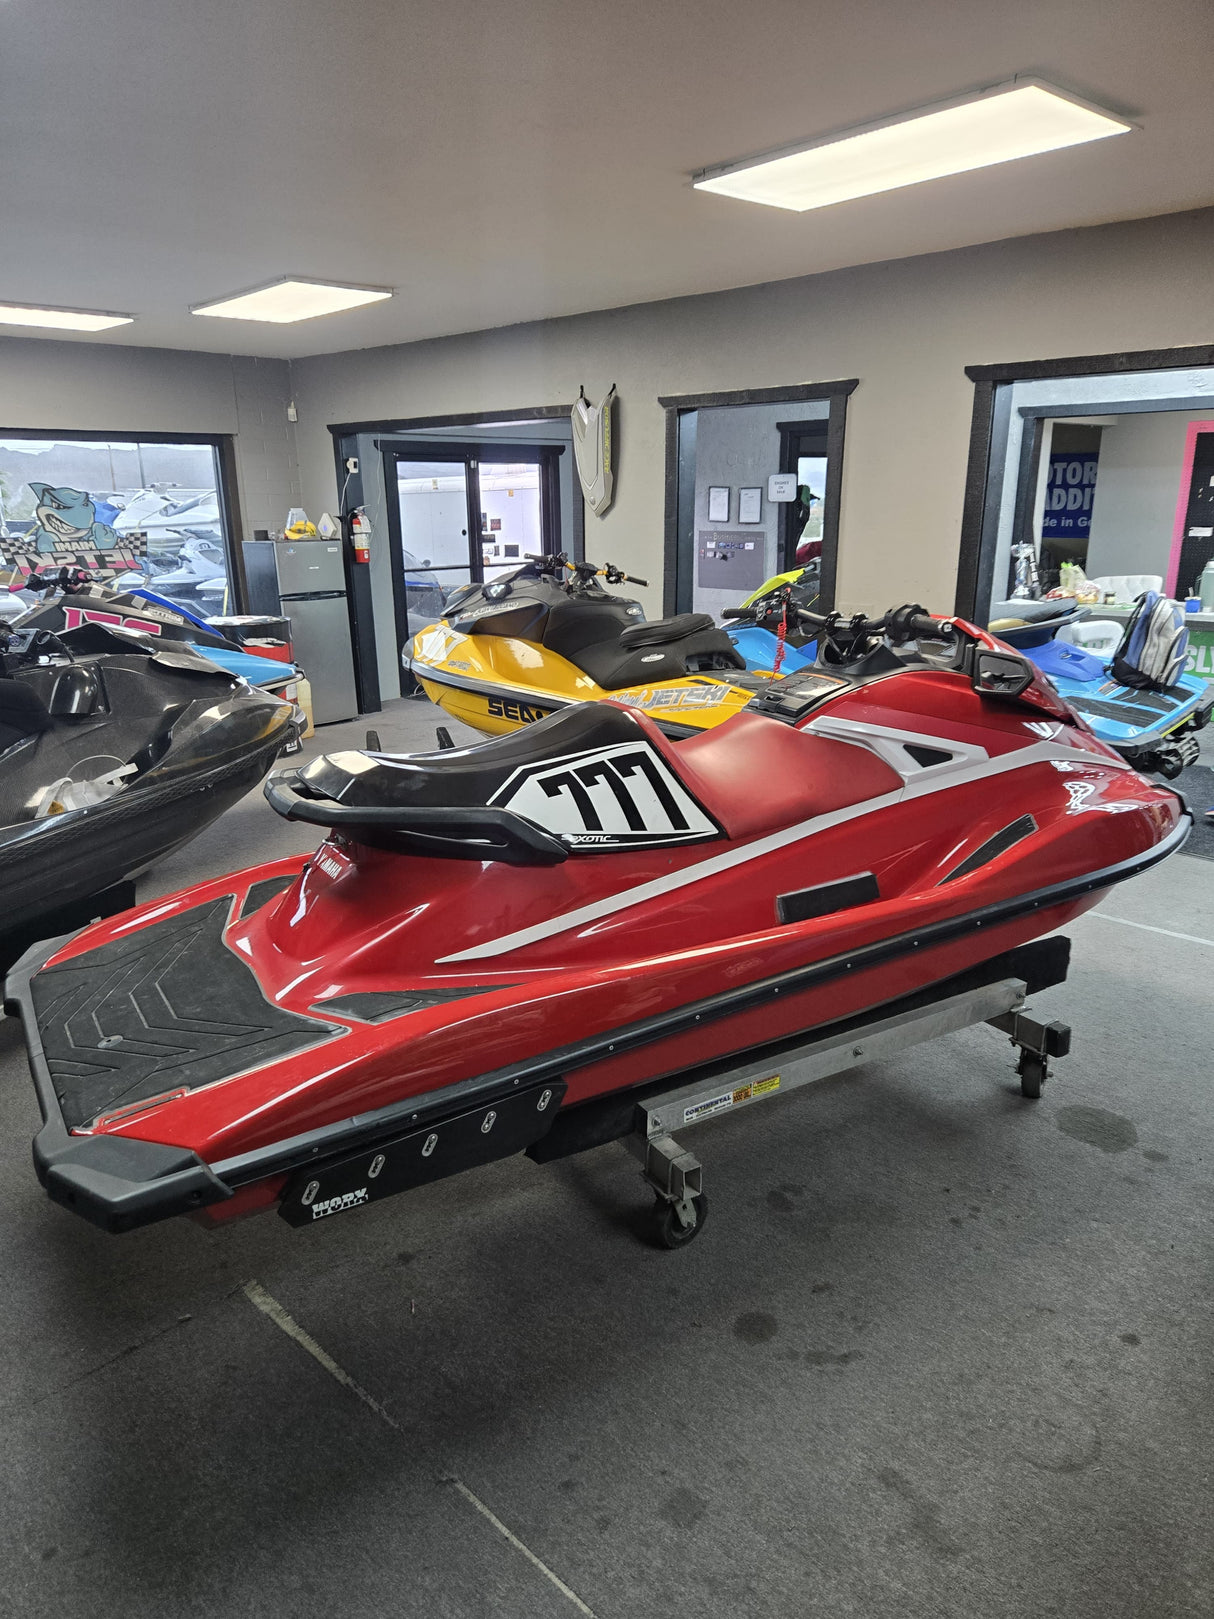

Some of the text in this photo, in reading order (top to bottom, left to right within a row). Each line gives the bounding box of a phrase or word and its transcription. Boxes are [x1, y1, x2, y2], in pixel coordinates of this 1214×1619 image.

[1045, 488, 1095, 510] DDI
[1061, 517, 1073, 527] in
[642, 685, 732, 710] JETSKI
[537, 751, 690, 831] 777
[317, 853, 342, 880] YAMAHA
[685, 1094, 732, 1116] CONTINENTAL
[312, 1188, 368, 1219] WORX
